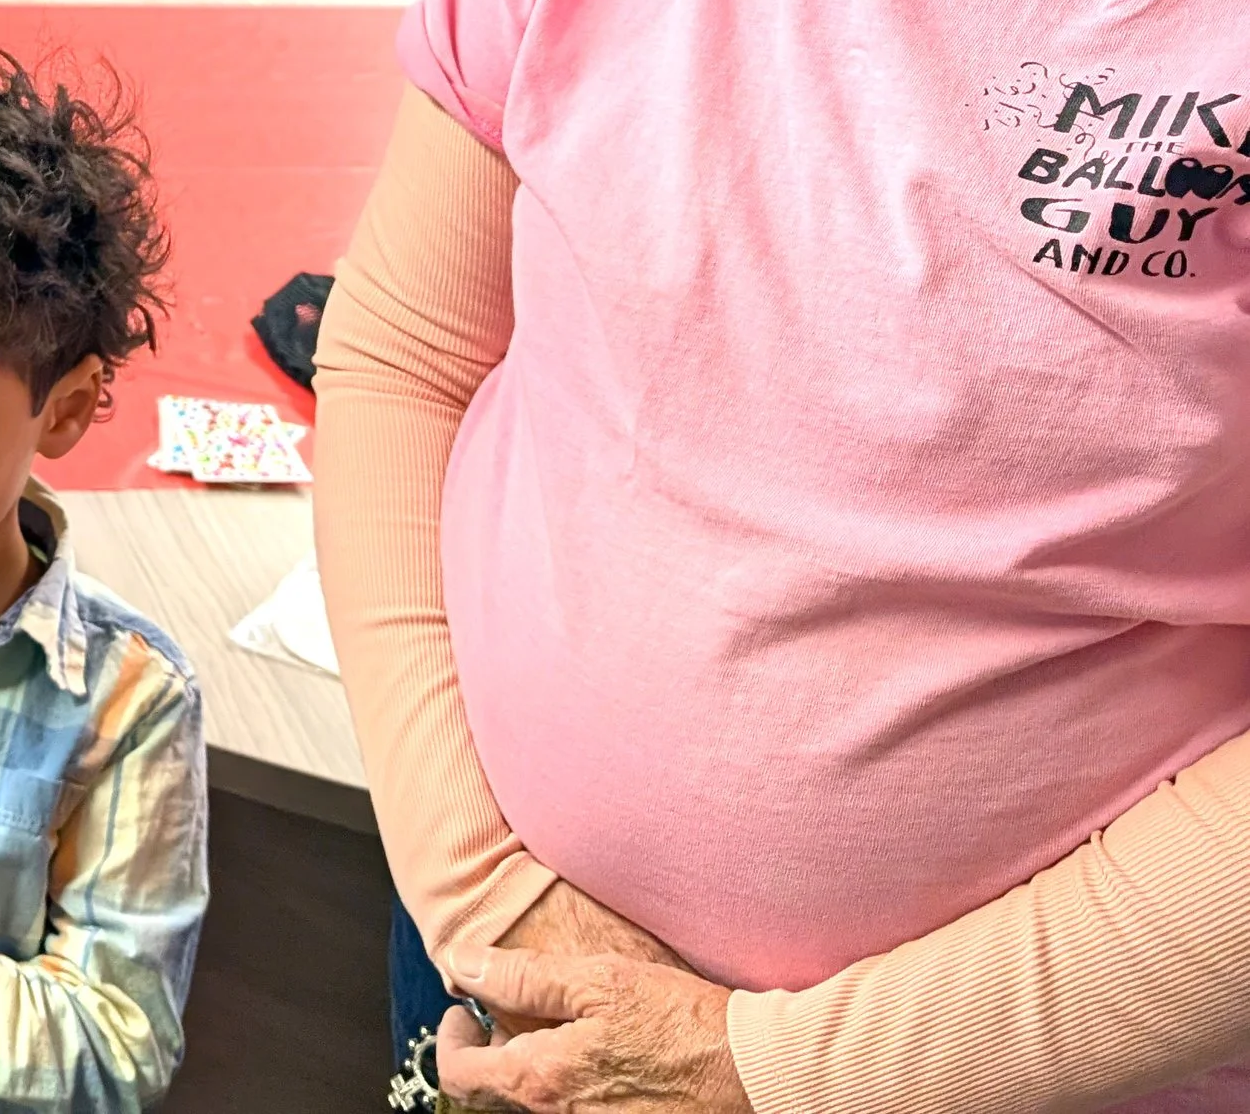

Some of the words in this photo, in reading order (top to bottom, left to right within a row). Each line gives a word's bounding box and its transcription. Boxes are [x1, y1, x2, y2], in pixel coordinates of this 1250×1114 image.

[1053, 82, 1250, 155] MIK
[1125, 141, 1185, 155] THE
[1020, 197, 1218, 244] GUY
[1033, 239, 1130, 276] AND
[1141, 250, 1196, 278] CO.
